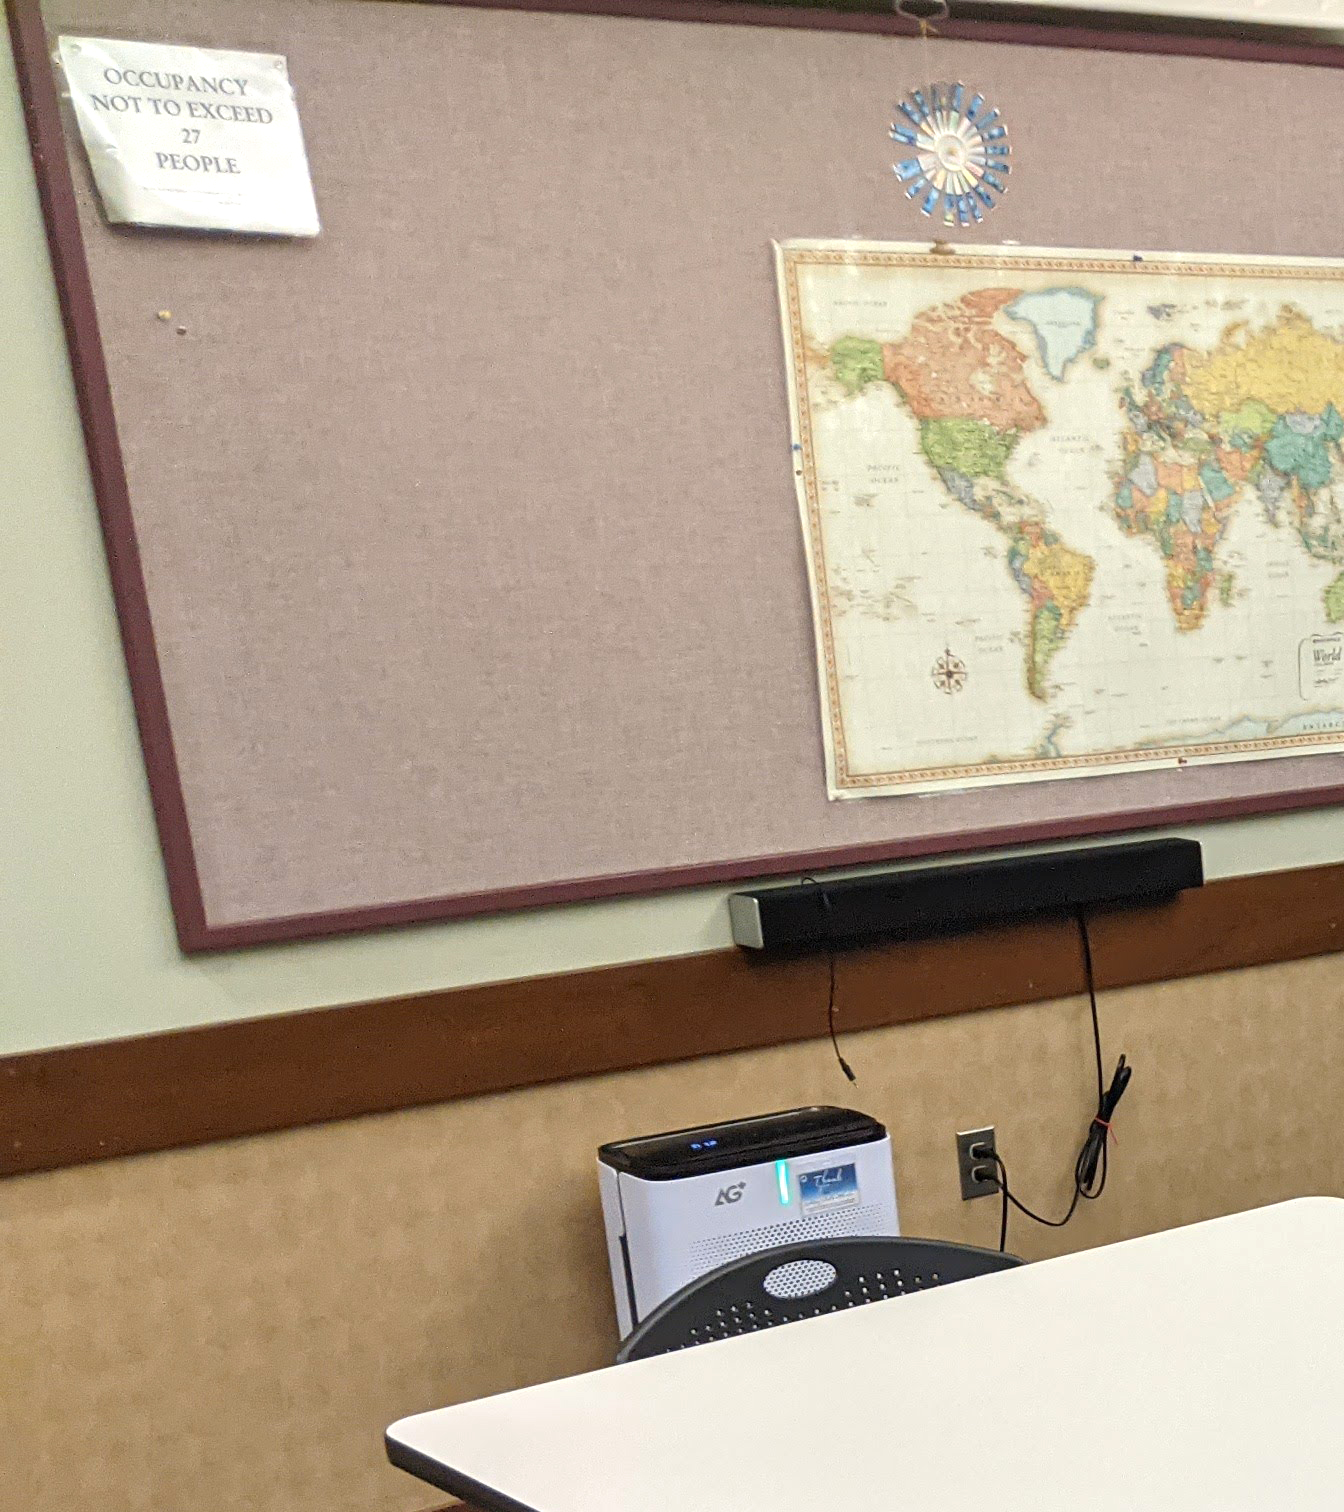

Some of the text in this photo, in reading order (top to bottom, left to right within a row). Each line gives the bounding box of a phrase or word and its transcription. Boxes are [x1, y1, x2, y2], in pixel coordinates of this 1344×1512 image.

[103, 68, 249, 97] OCCUPANCY
[89, 94, 273, 125] NOT TO EXCEED
[181, 128, 201, 145] 27
[155, 152, 242, 175] PEOPLE
[1313, 645, 1343, 662] World
